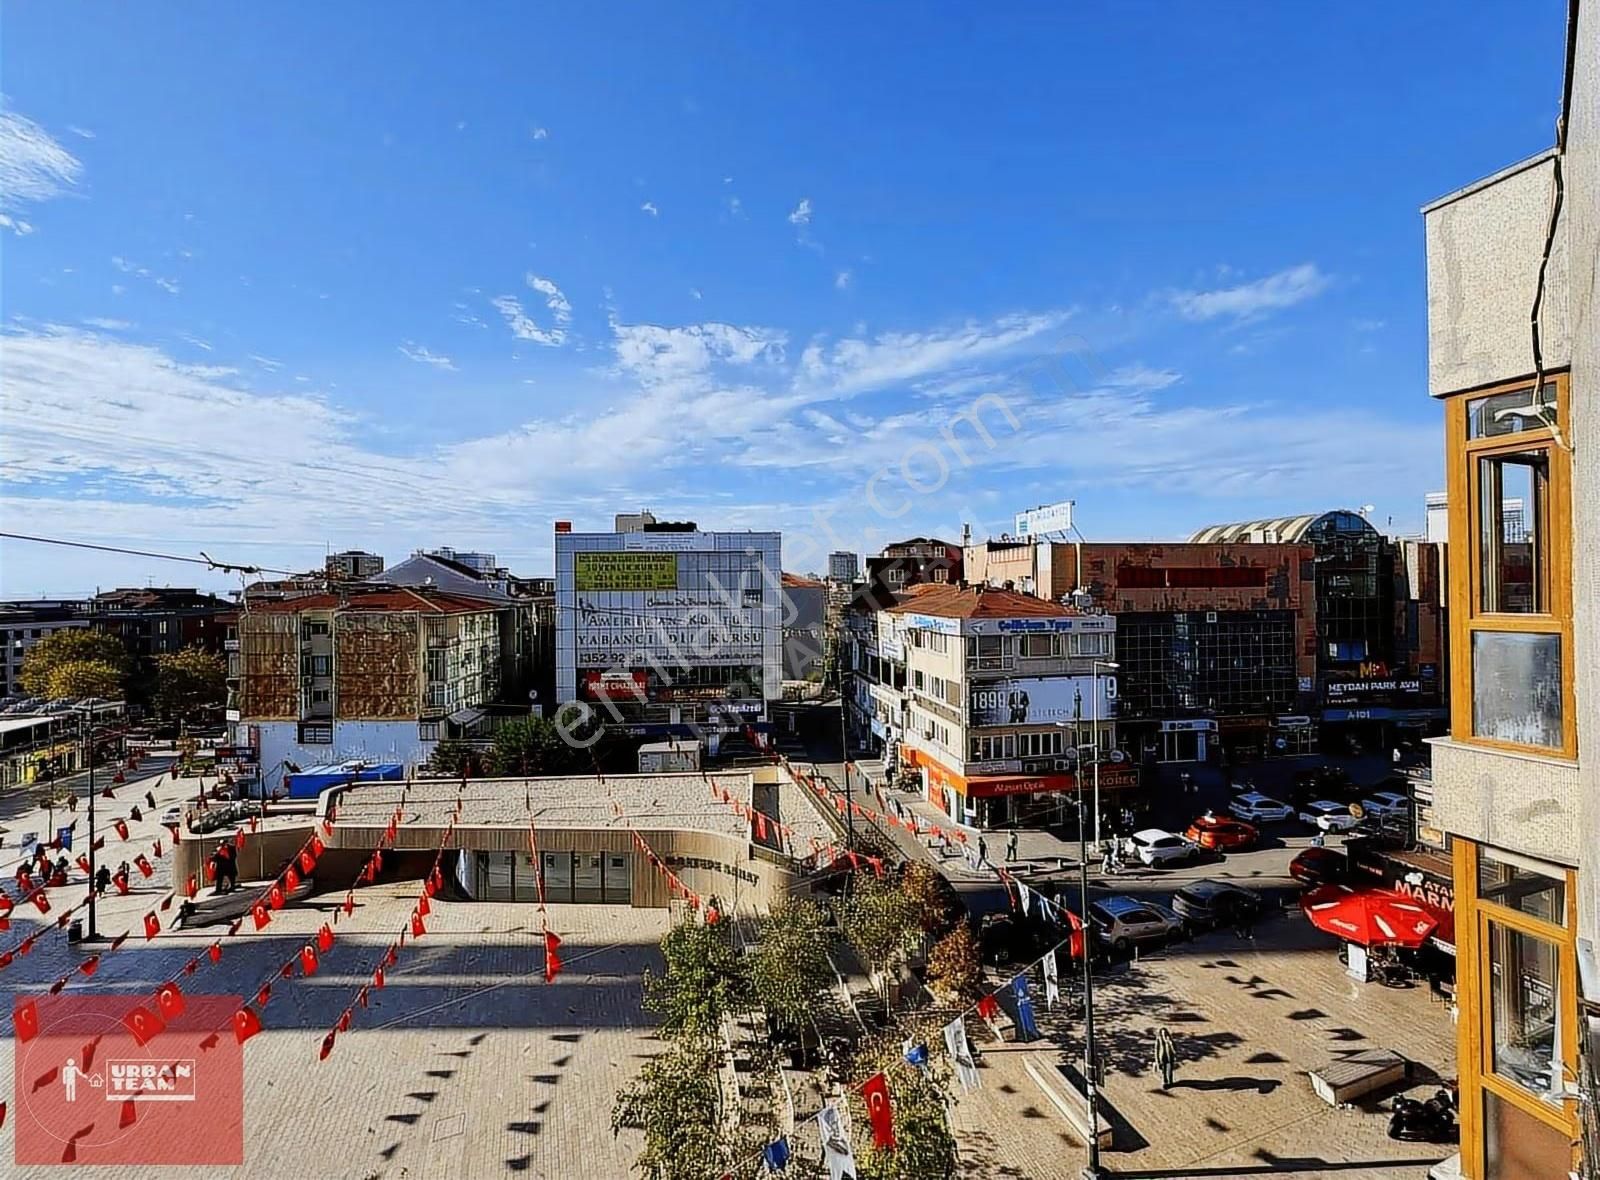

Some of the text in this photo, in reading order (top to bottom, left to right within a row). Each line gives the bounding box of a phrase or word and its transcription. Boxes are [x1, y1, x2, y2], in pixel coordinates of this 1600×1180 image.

[578, 634, 654, 646] YABANCI
[711, 632, 762, 643] KURSU
[1371, 682, 1396, 690] PARK
